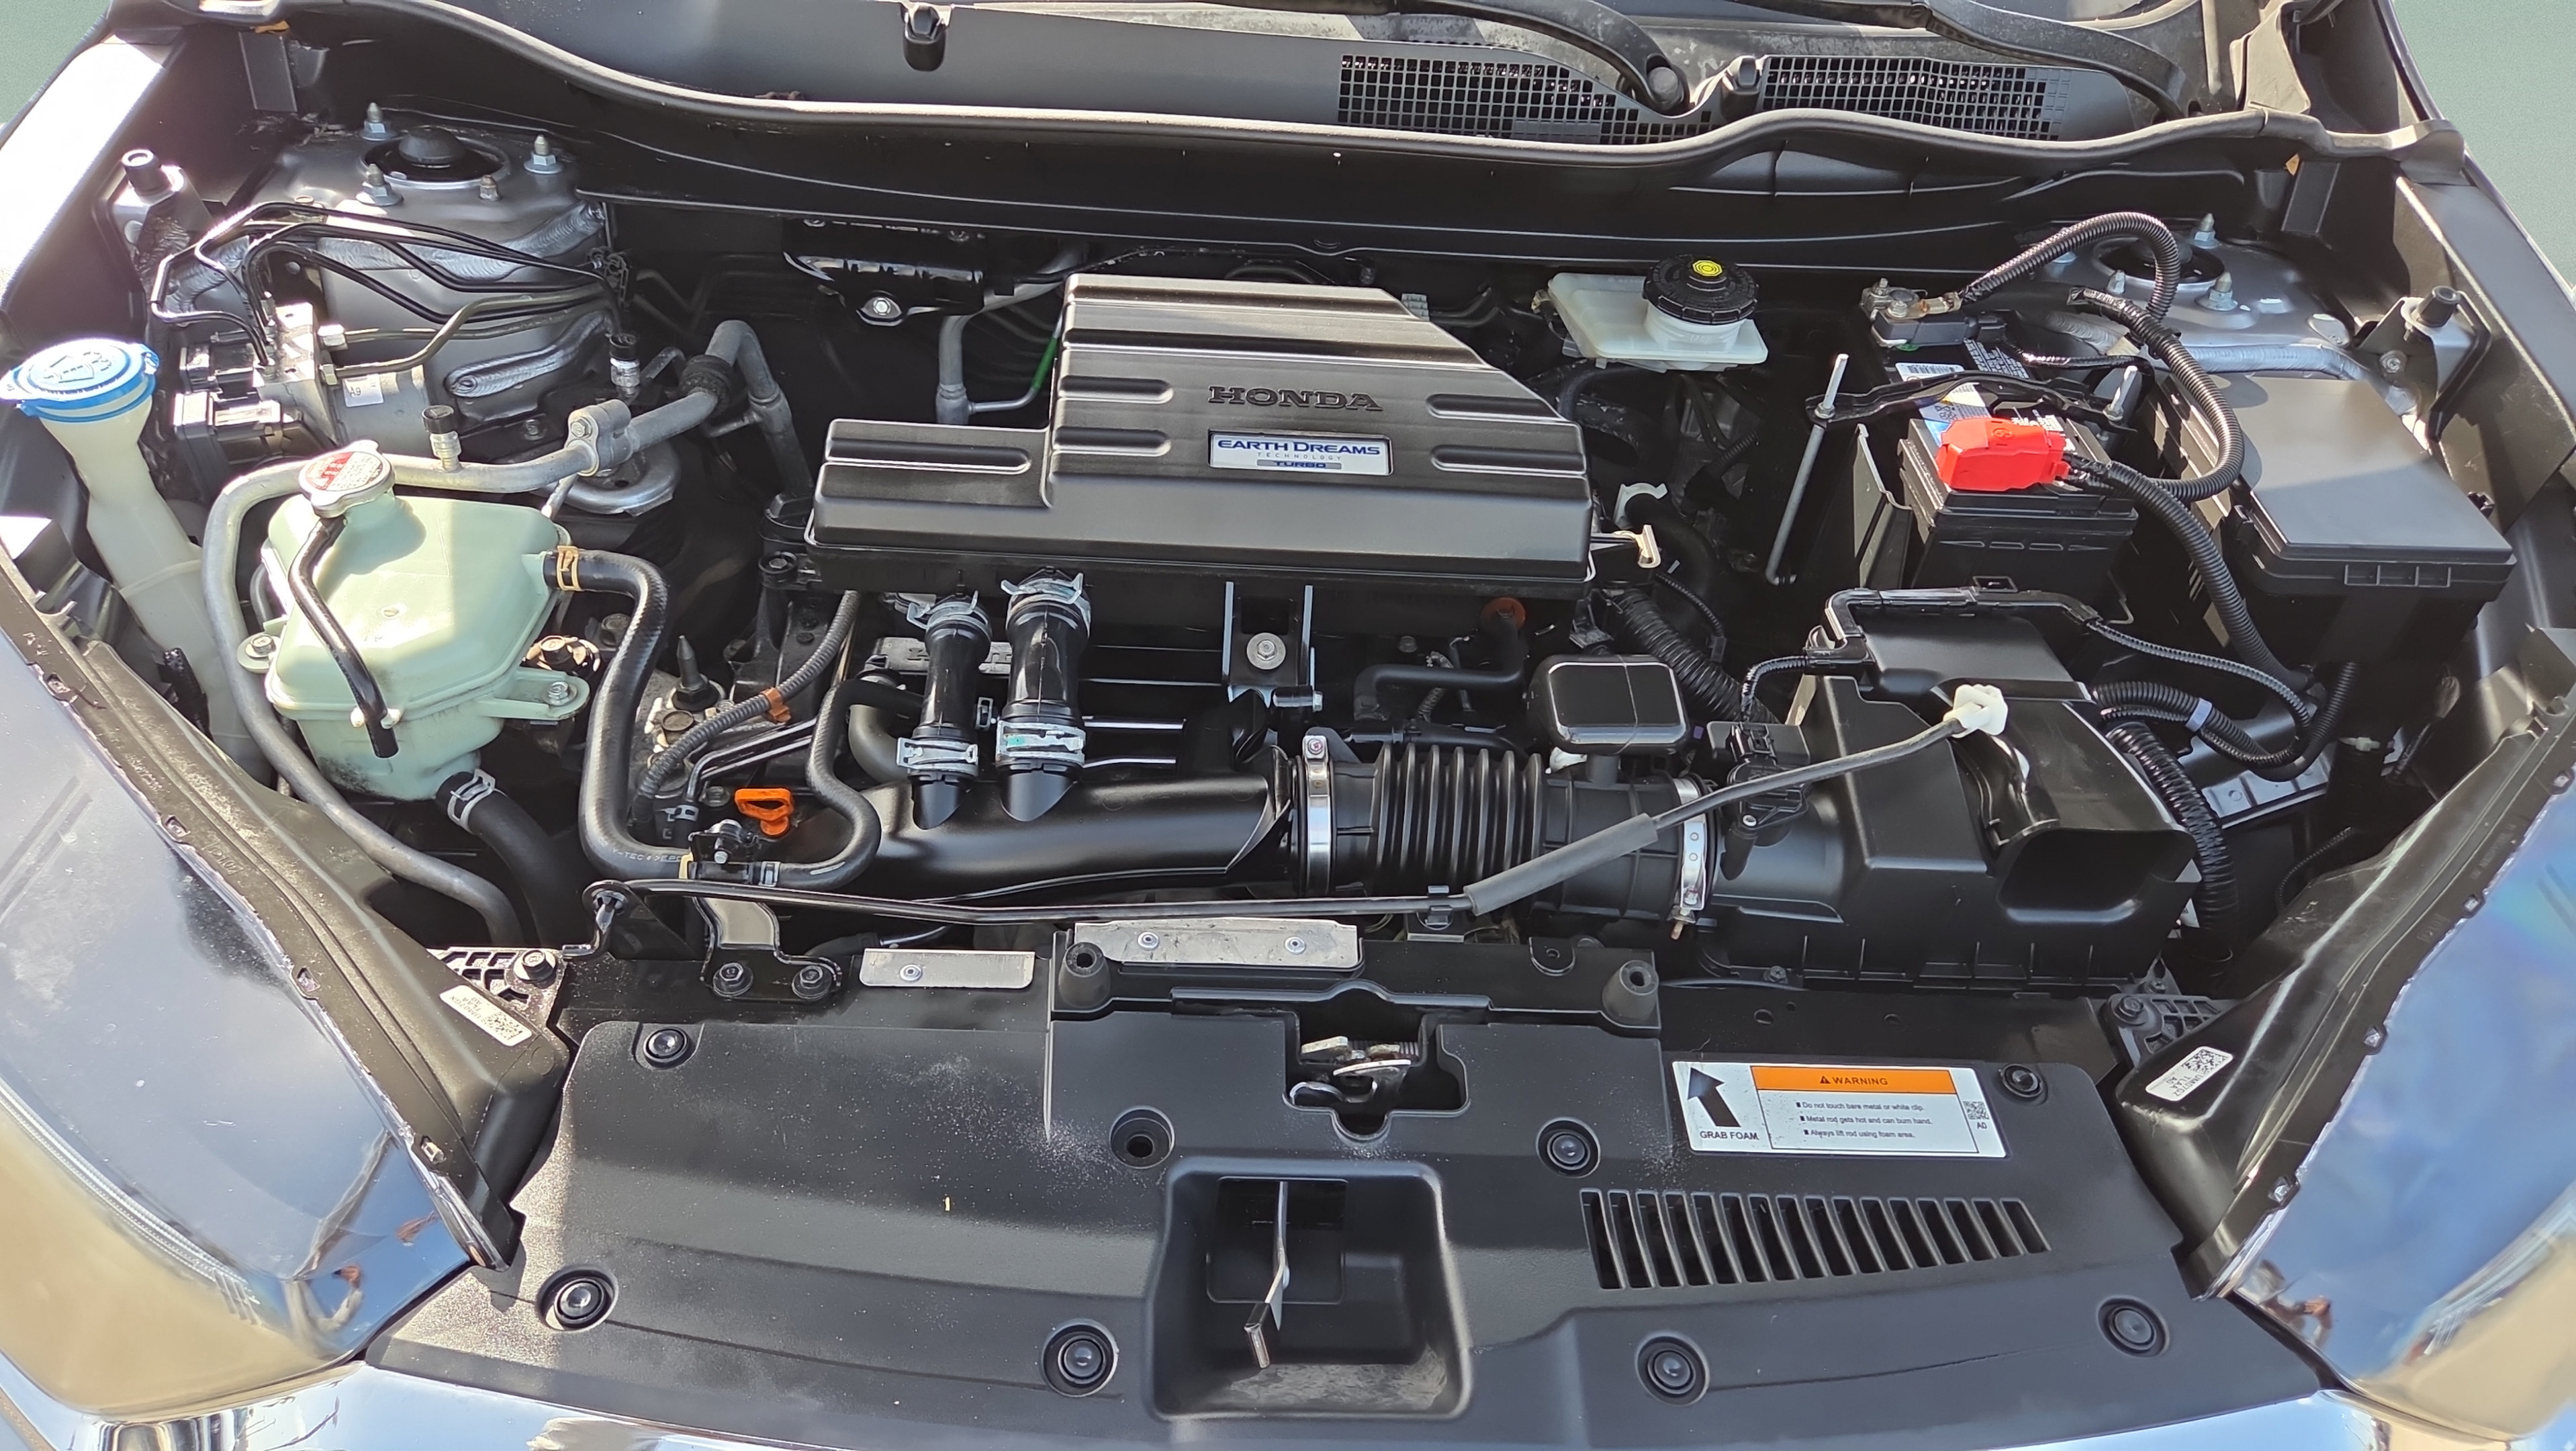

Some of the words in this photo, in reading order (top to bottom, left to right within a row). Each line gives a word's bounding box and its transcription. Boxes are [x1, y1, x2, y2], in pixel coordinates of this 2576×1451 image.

[1208, 386, 1383, 411] HONDA
[1217, 439, 1288, 451] EARTH
[1293, 441, 1381, 455] DREAMS
[1257, 452, 1342, 460] TECHNOLOGY
[1273, 461, 1327, 469] TURBO
[612, 848, 644, 861] Y-TEC
[1832, 1076, 1889, 1086] WARNING
[1700, 1131, 1727, 1139] GRAB
[1730, 1132, 1759, 1141] FOAM
[1810, 1130, 1835, 1138] Always
